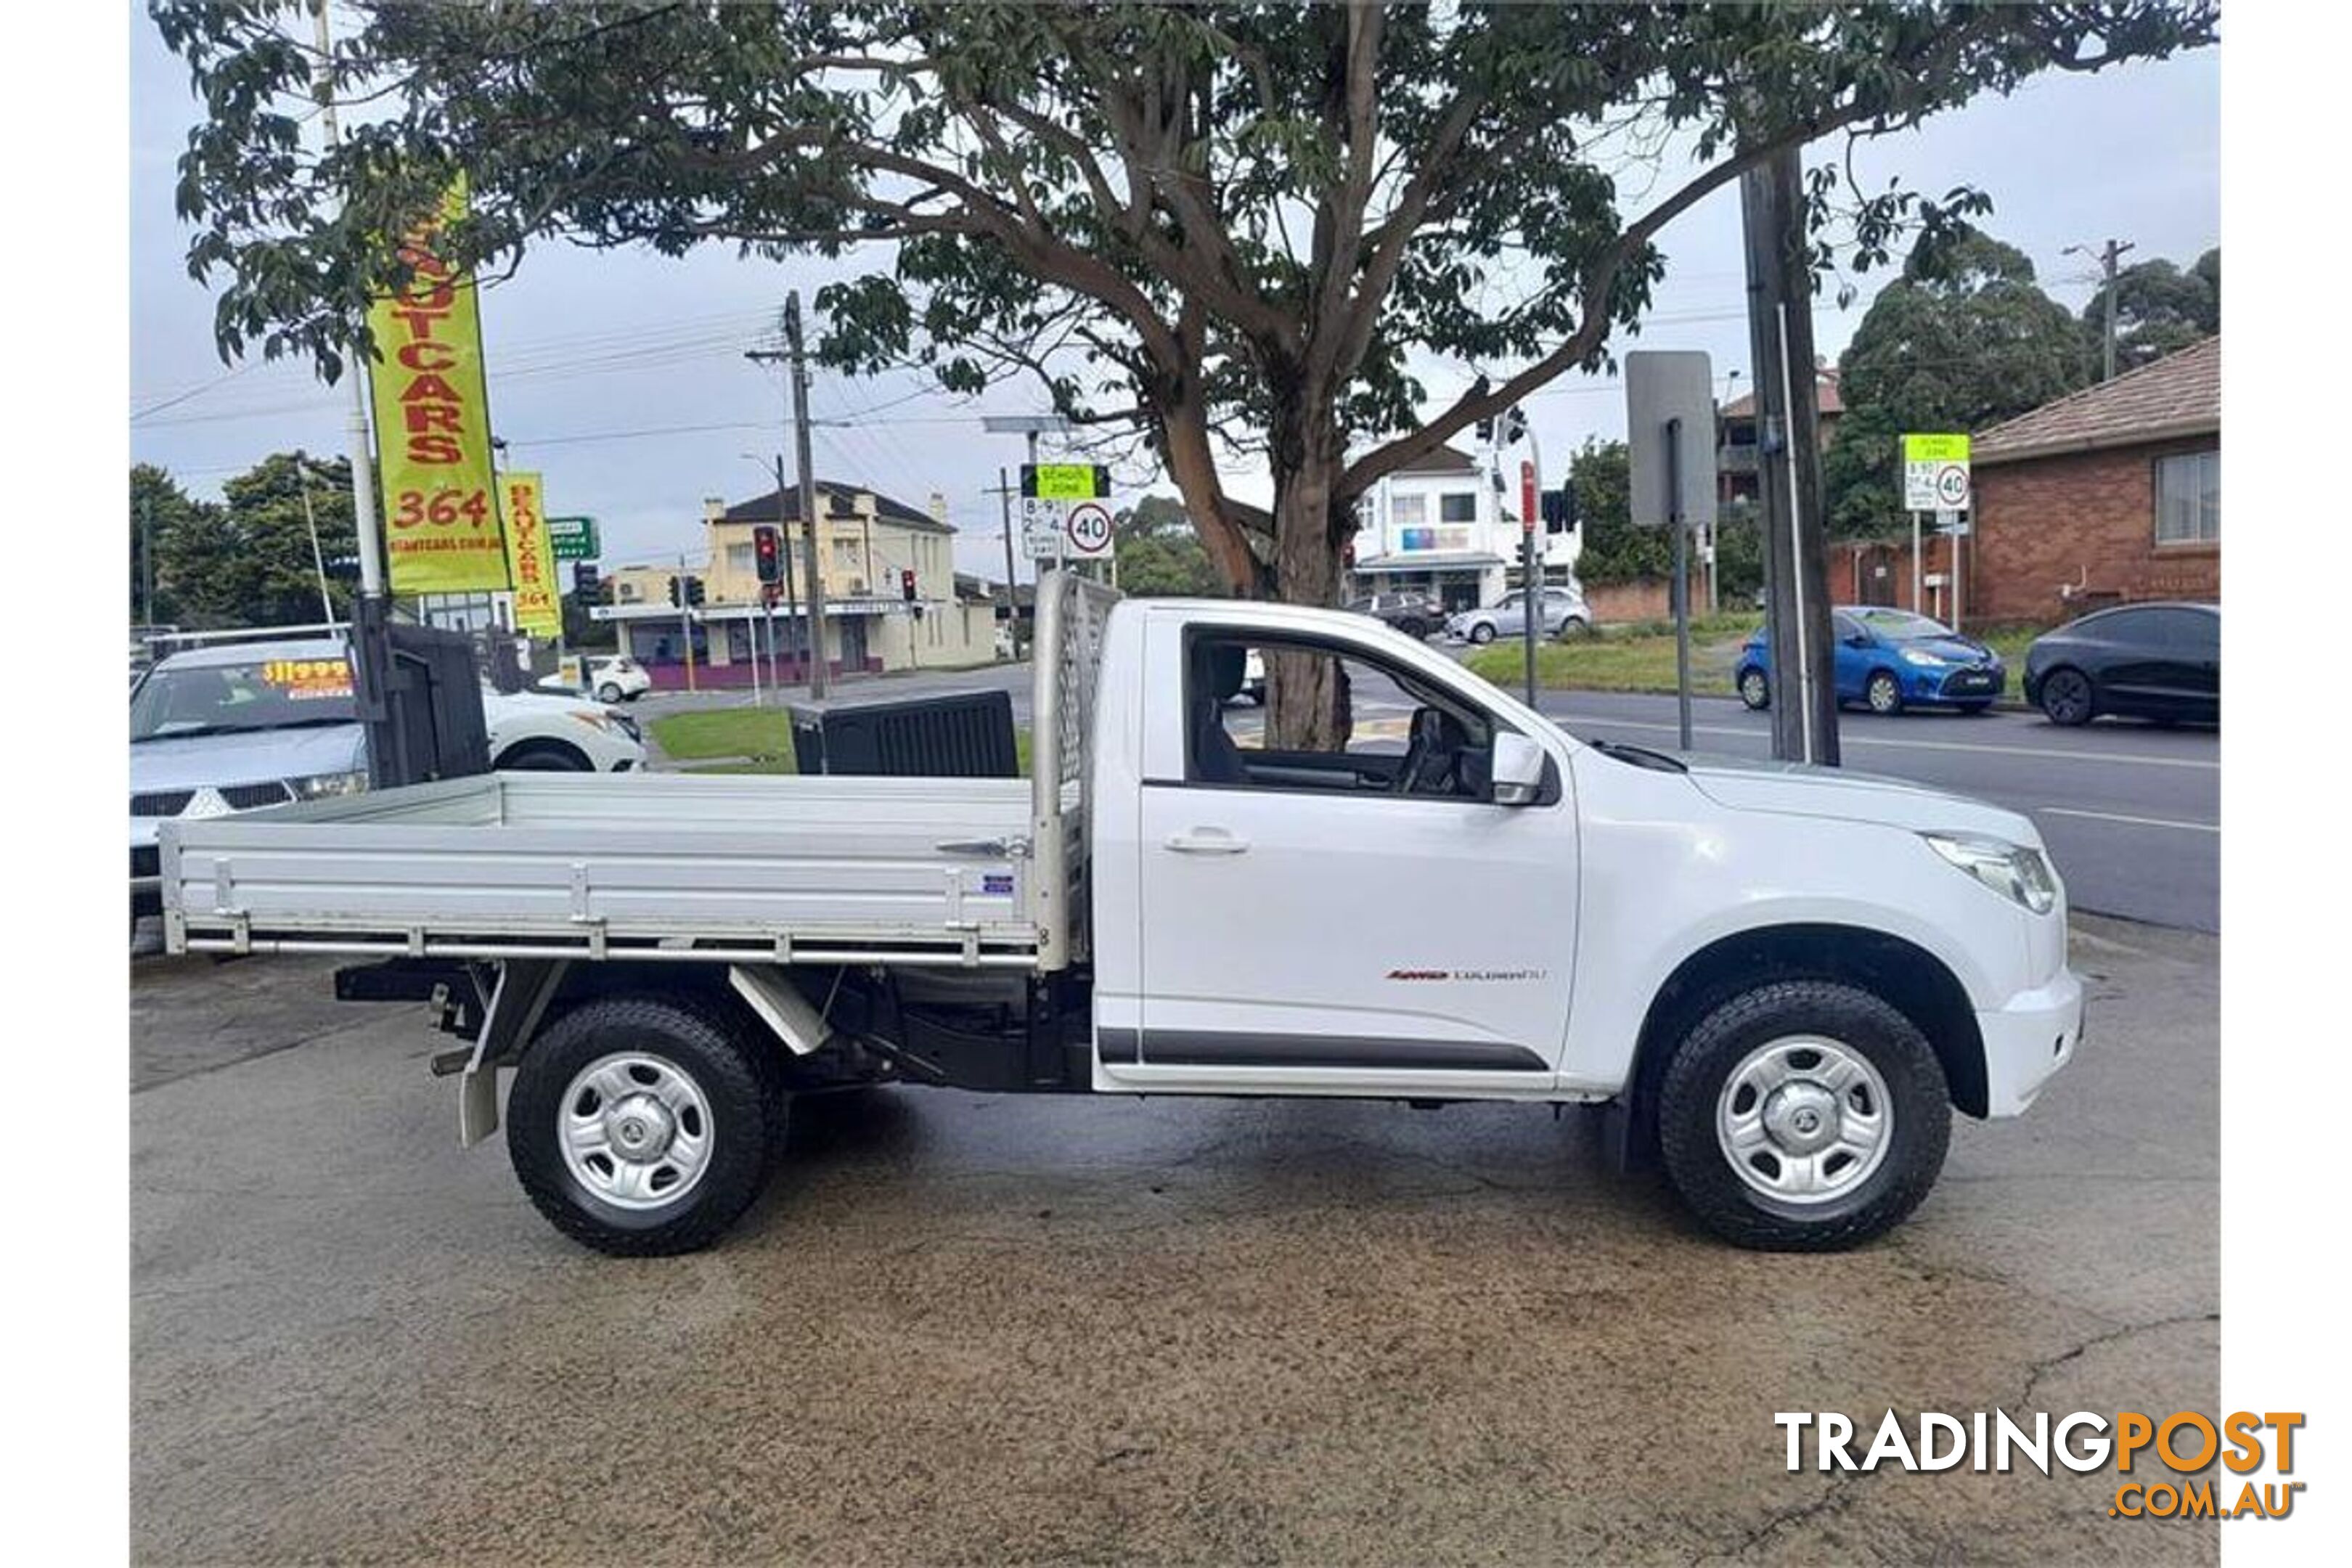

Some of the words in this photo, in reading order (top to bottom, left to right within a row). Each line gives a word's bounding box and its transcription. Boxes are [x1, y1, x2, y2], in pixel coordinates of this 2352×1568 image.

[1943, 475, 1962, 493] 40
[393, 487, 487, 529] 364
[1076, 517, 1106, 538] 40
